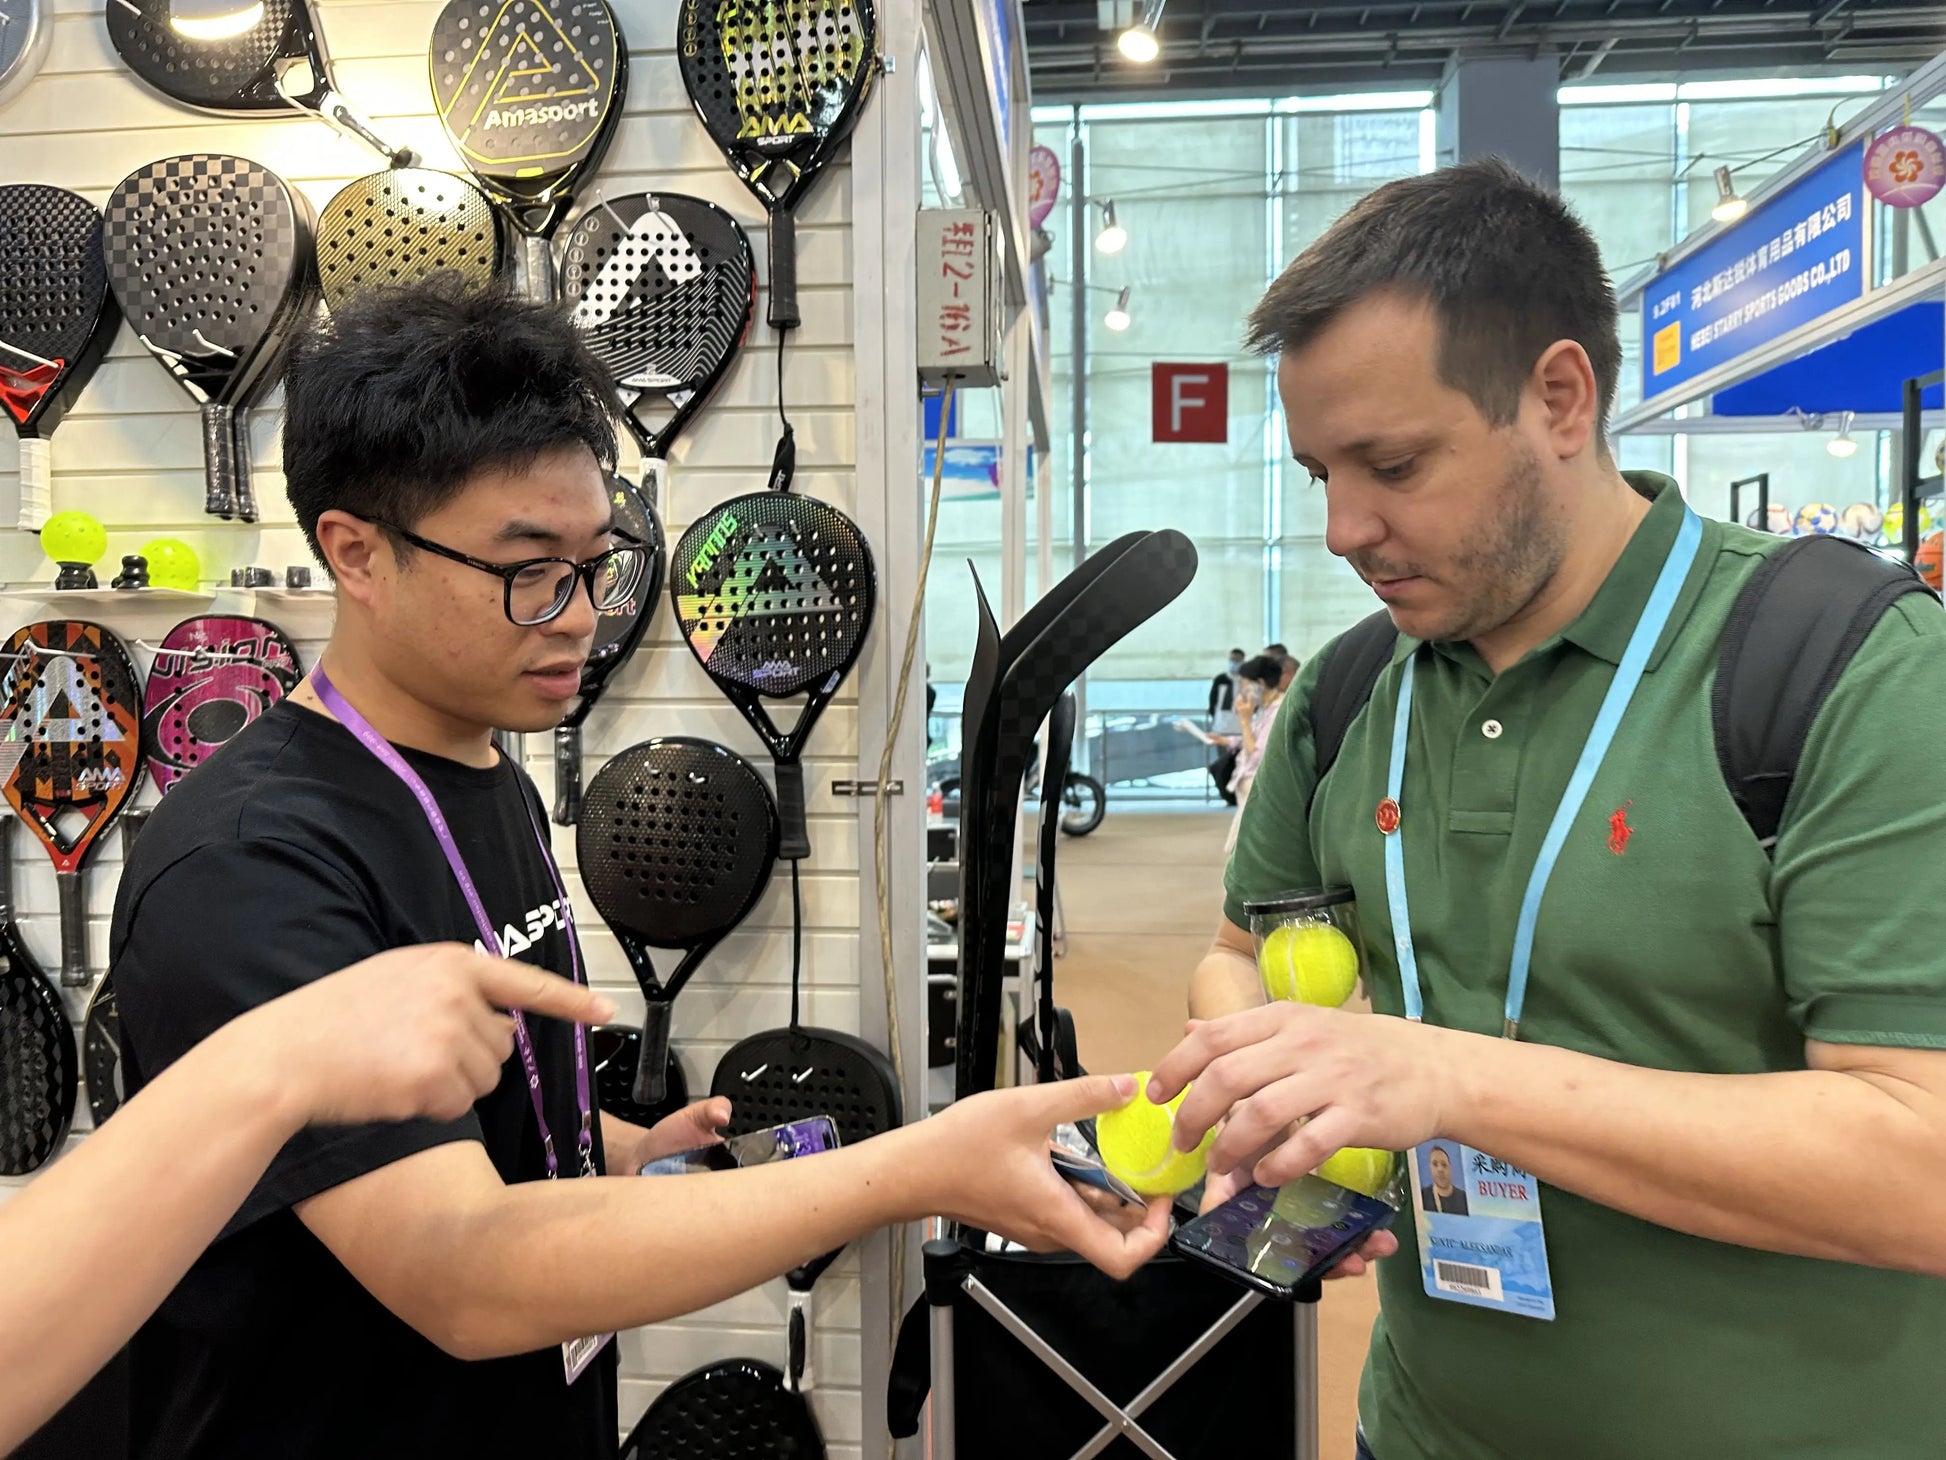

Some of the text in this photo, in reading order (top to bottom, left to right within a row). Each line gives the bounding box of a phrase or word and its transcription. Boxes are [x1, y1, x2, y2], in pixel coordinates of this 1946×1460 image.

[756, 134, 796, 146] SPORT
[1744, 288, 1777, 323] SPORTS
[1778, 270, 1810, 306] GOODS
[1171, 374, 1209, 432] F
[1477, 1180, 1528, 1201] BUYER
